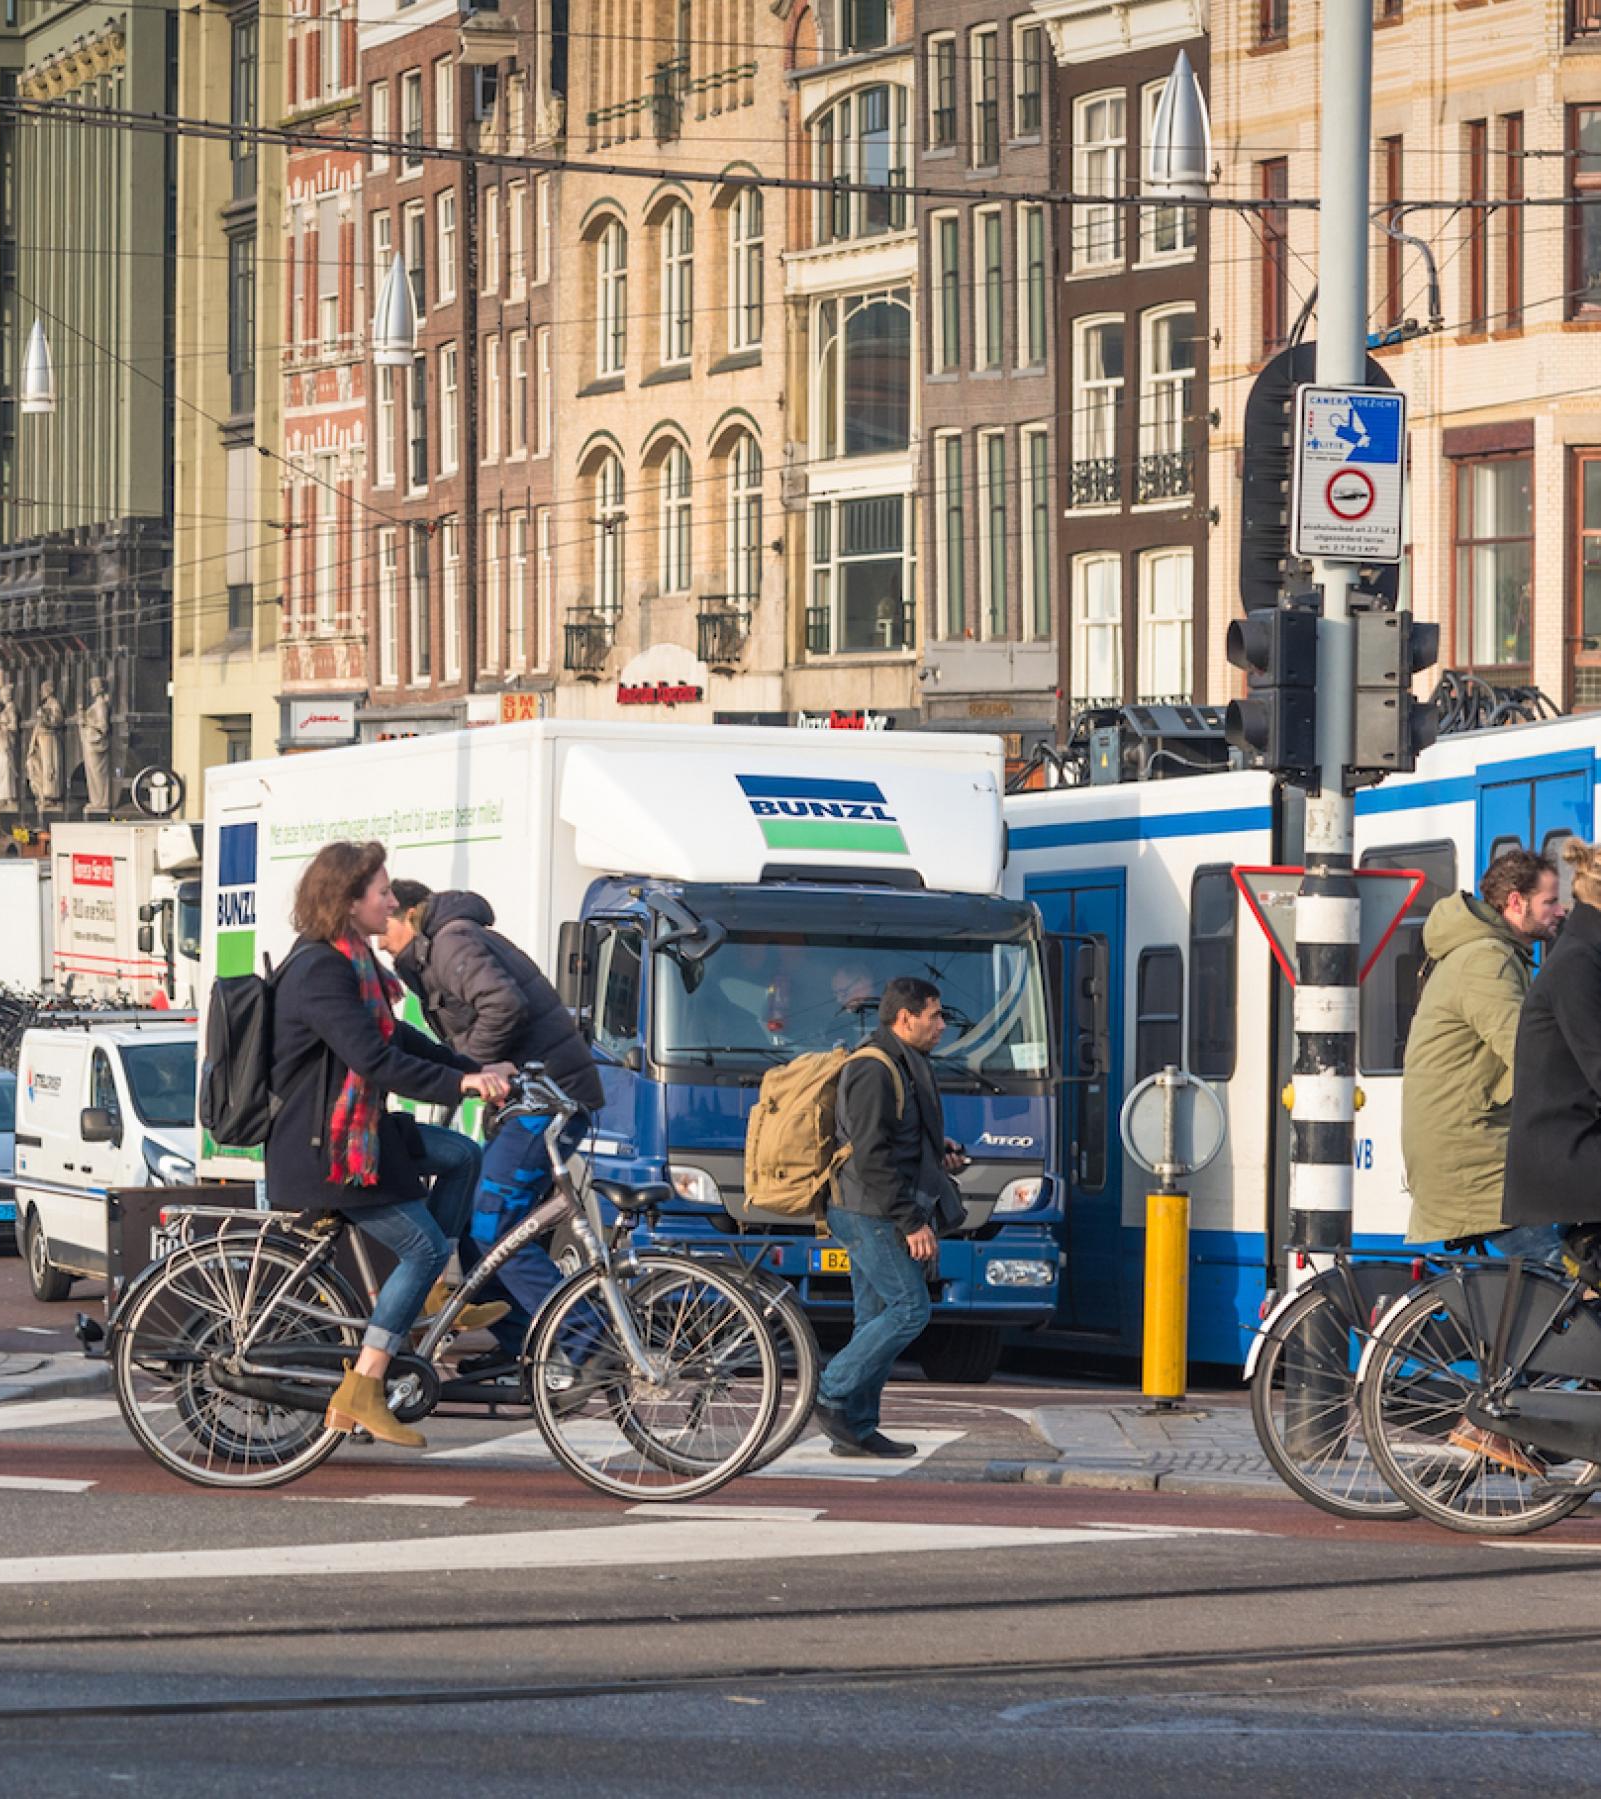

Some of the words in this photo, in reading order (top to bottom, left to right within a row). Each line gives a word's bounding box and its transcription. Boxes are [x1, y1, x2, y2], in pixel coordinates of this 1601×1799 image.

[750, 801, 897, 822] BUNZL
[217, 891, 256, 926] BUNZL
[465, 1217, 540, 1291] MONTEGO
